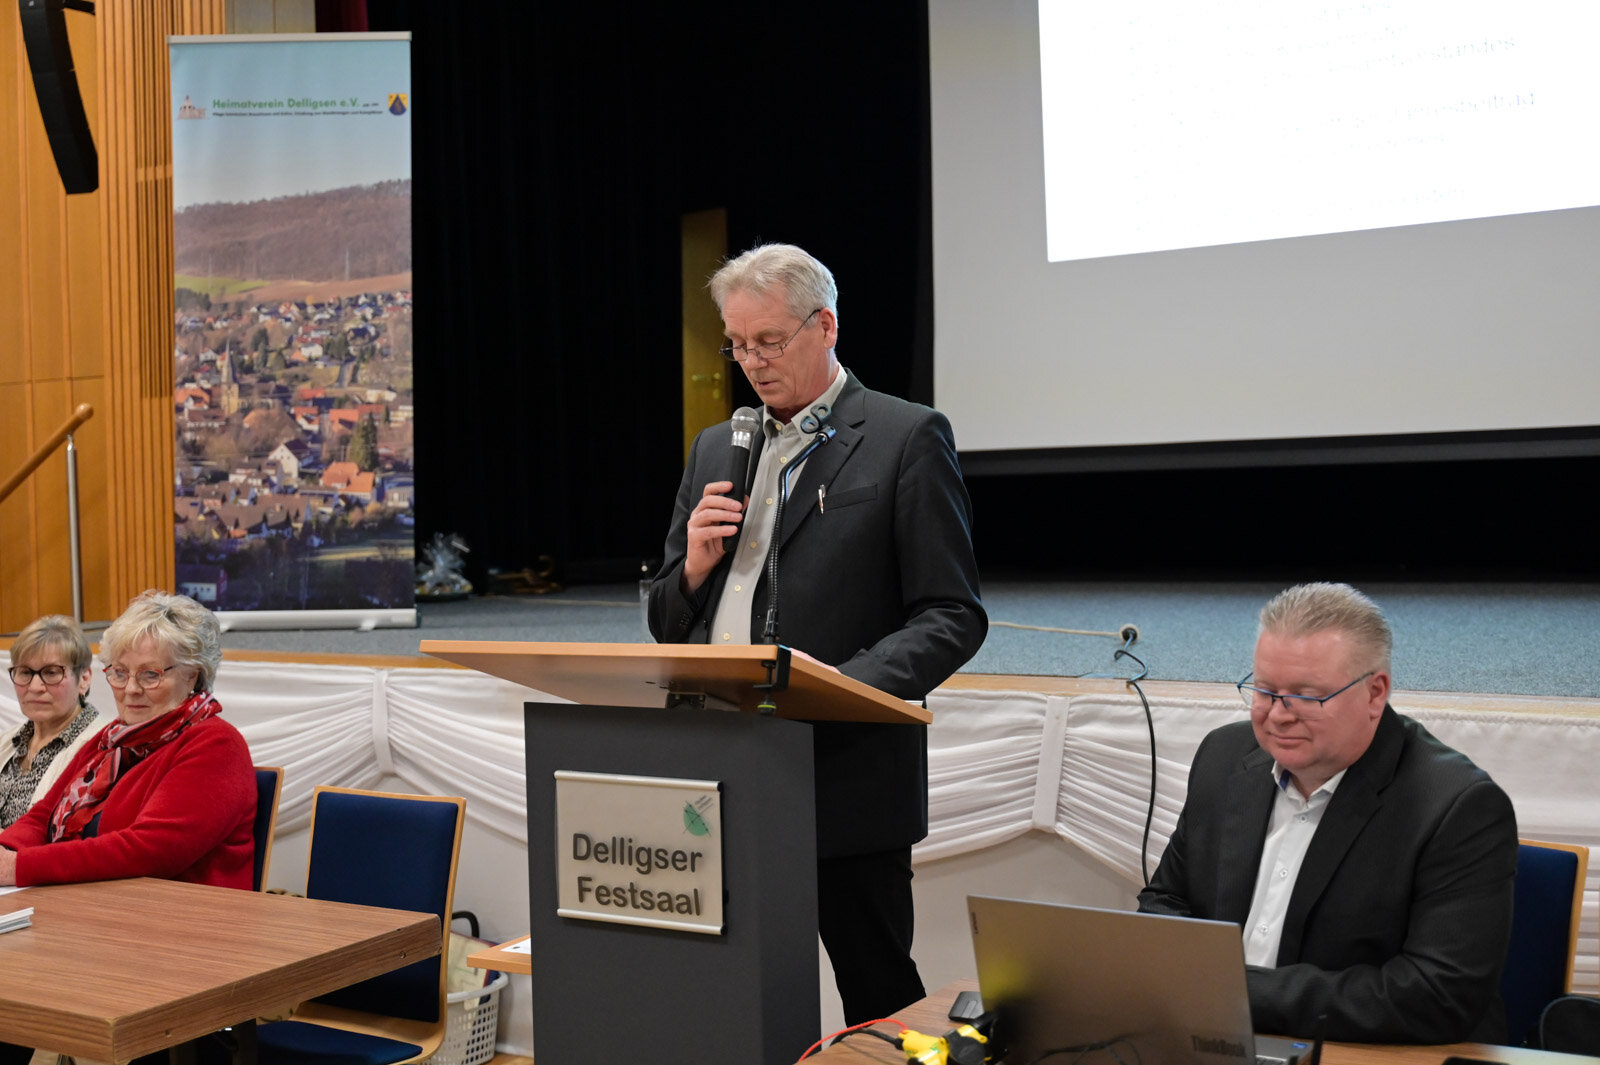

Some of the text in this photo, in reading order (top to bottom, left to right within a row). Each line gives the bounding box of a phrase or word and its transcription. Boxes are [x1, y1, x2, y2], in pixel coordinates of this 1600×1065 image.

[212, 98, 284, 109] Heimatverein
[287, 98, 336, 109] Delligsen
[572, 832, 703, 876] Delligser
[576, 876, 701, 917] Festsaal
